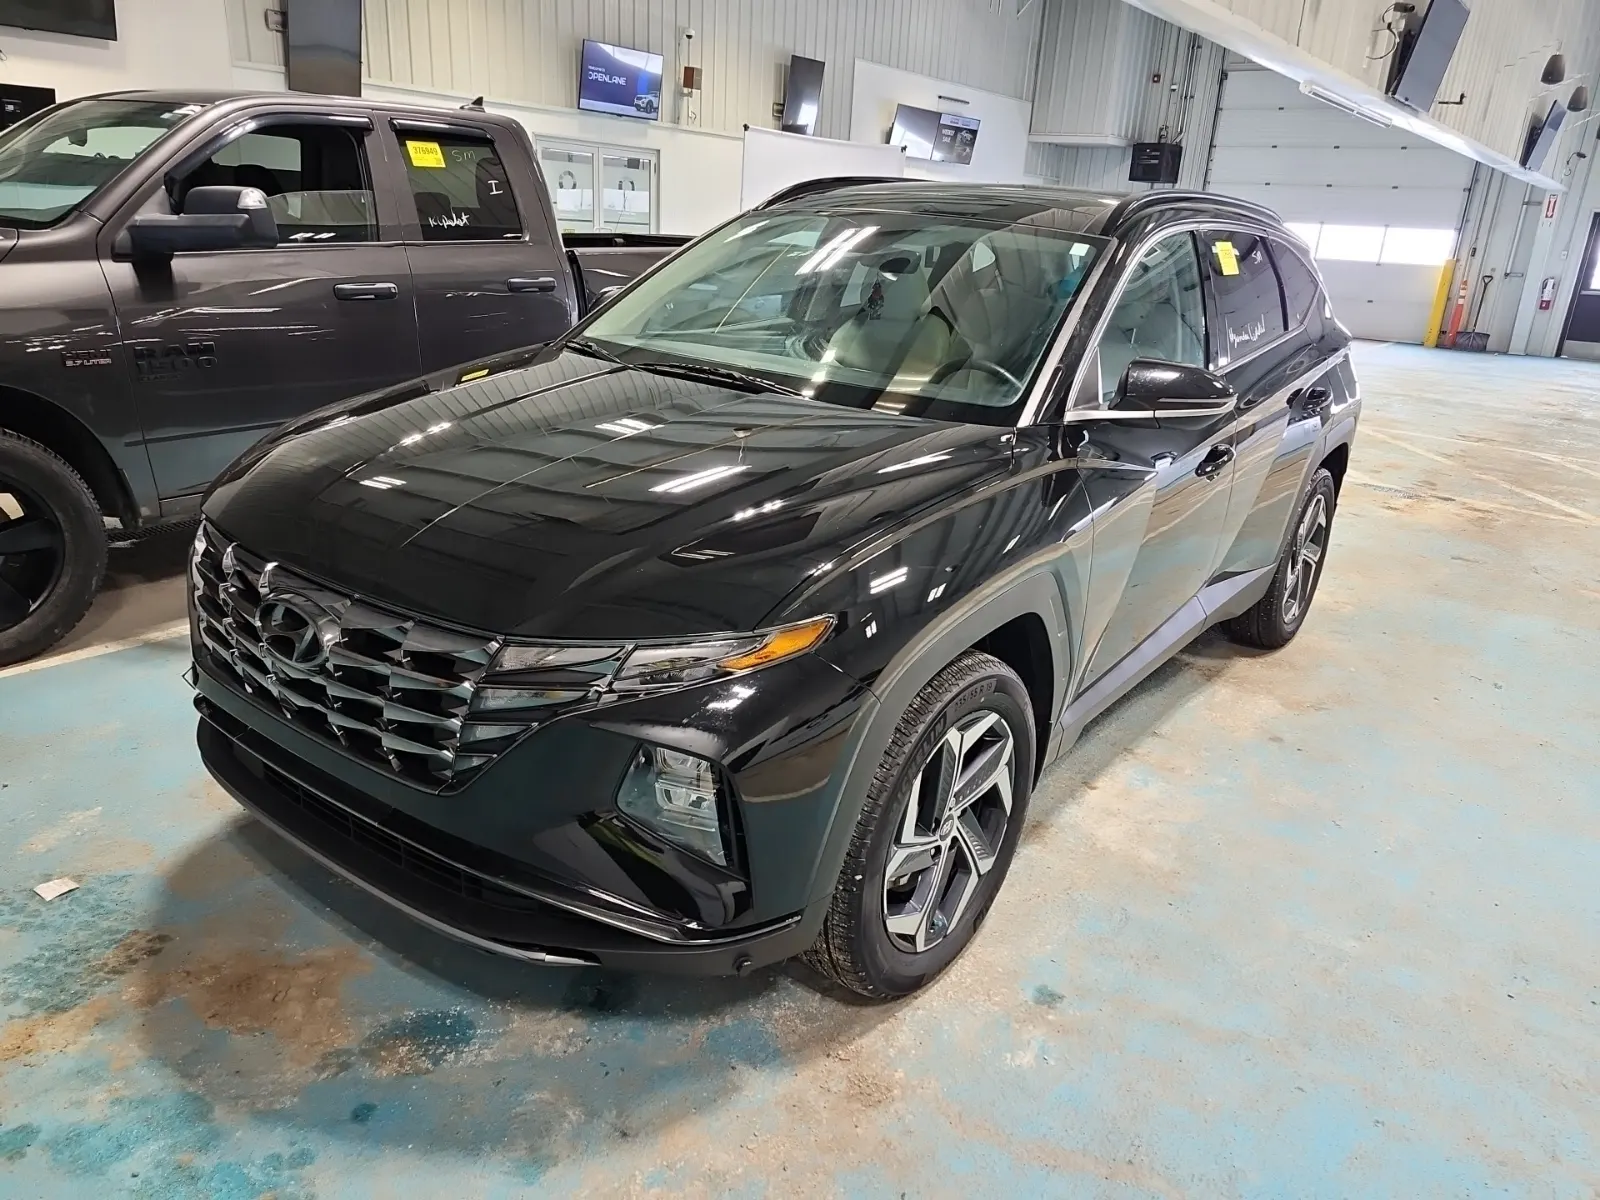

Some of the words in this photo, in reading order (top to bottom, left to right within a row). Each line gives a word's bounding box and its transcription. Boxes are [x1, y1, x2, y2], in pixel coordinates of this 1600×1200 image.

[587, 71, 627, 86] OPENLANE
[133, 341, 216, 360] RAM
[84, 358, 112, 366] LITER
[134, 356, 218, 375] 1500
